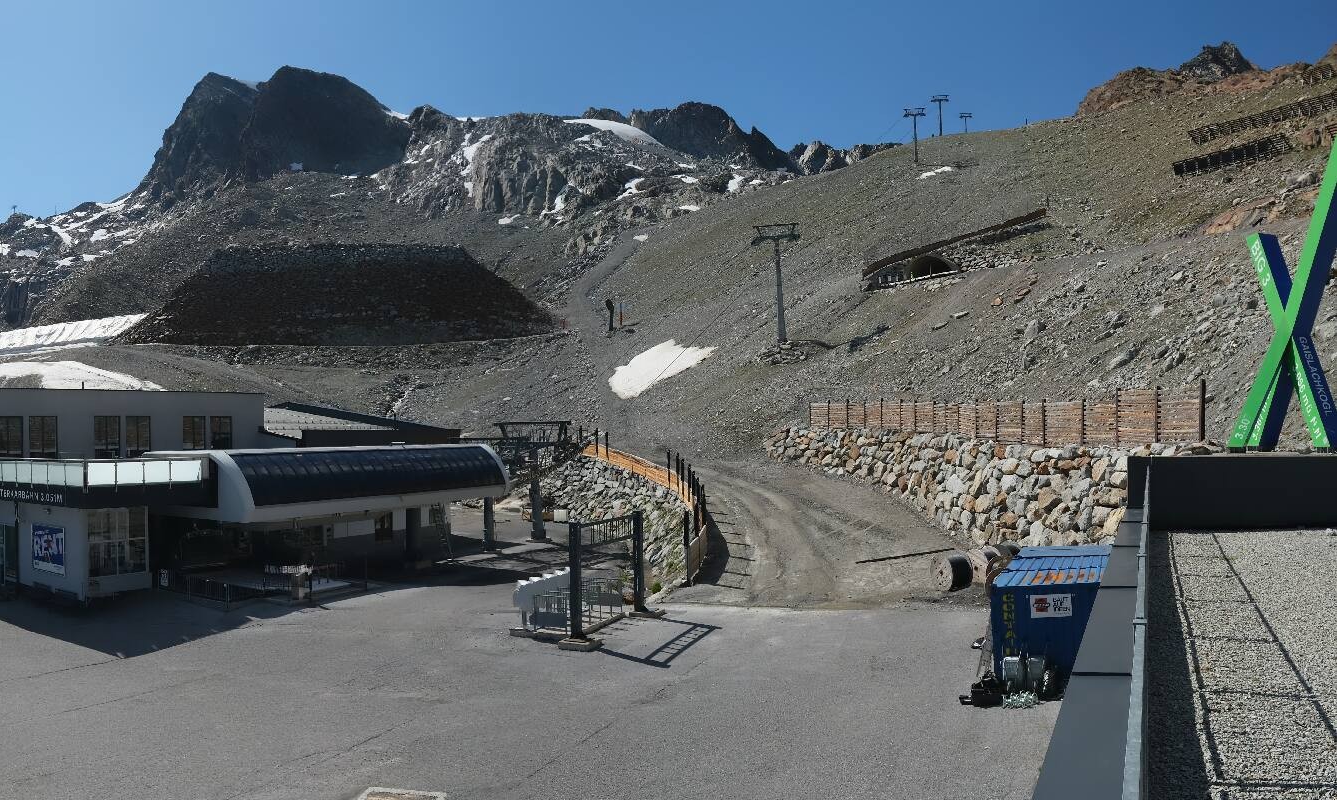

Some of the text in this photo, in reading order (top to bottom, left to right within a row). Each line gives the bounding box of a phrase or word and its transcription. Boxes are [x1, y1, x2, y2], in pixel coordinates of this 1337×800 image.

[1251, 239, 1271, 287] BIG 3
[1298, 336, 1333, 416] GAISLACHKOGL
